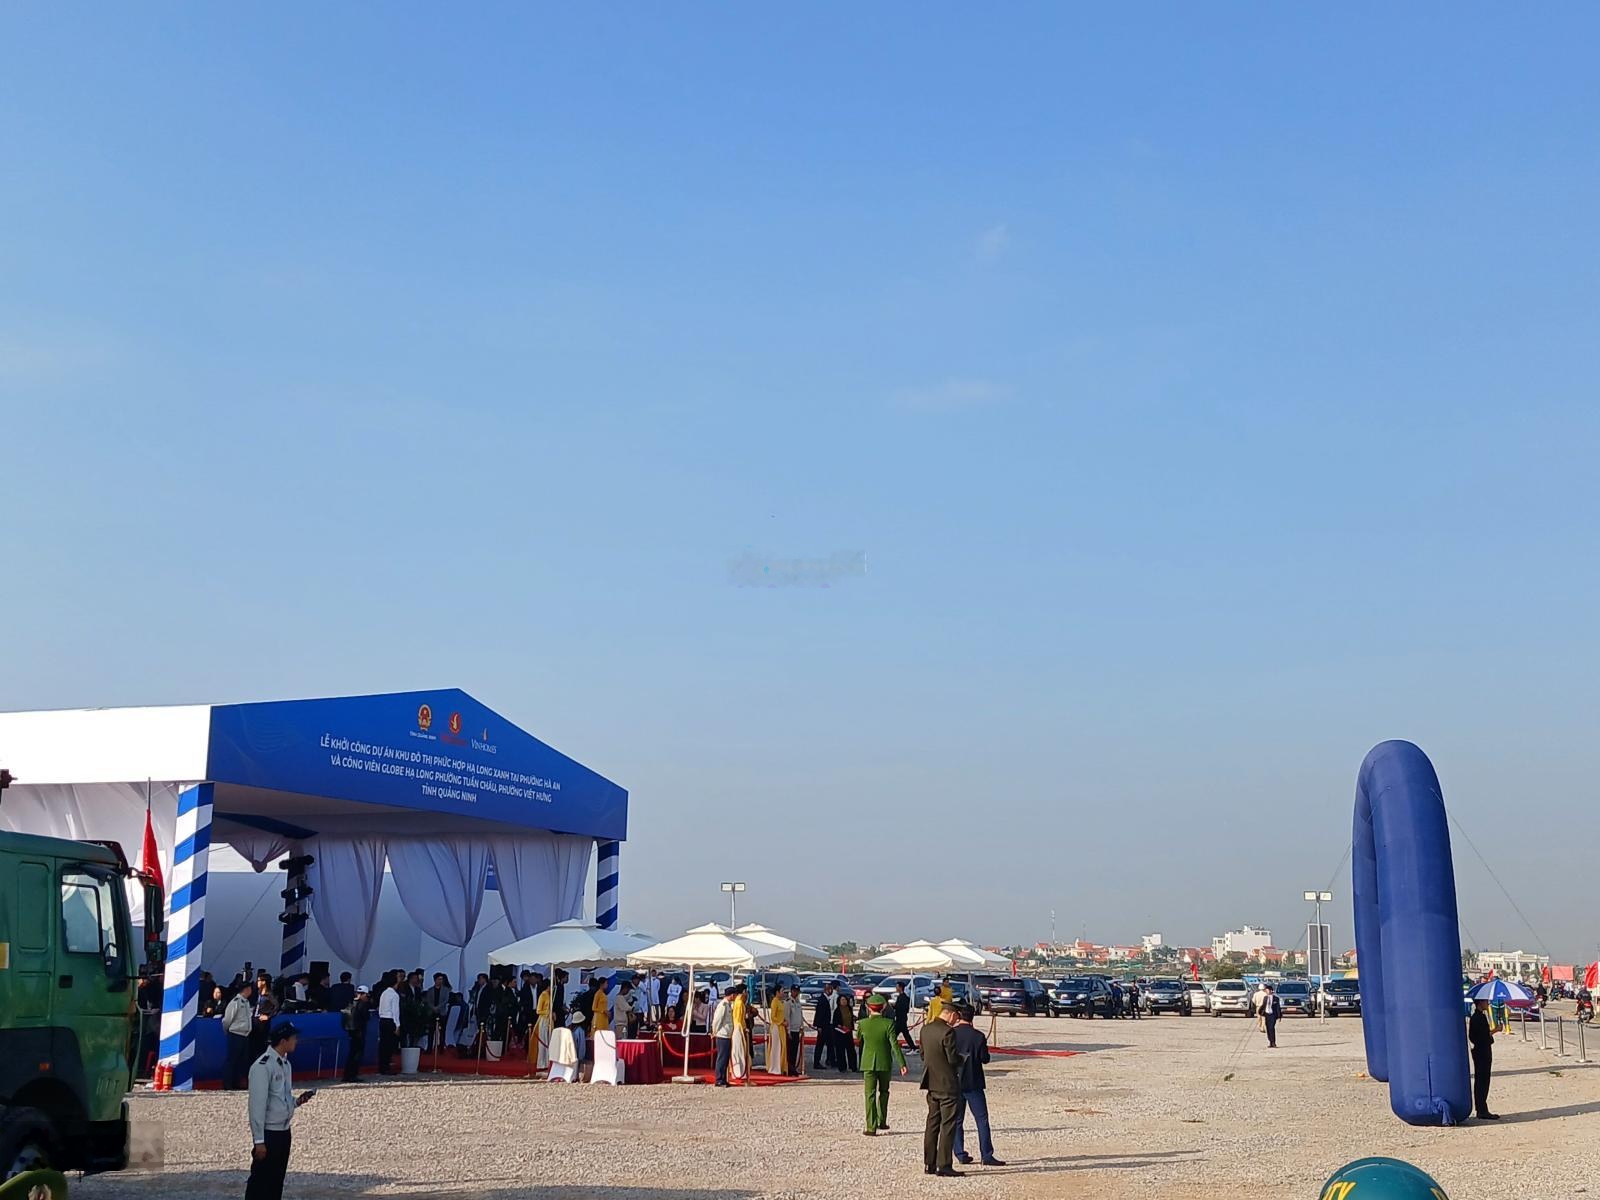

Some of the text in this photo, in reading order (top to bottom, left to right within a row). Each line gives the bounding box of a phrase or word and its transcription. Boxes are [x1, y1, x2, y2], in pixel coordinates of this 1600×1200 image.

[331, 753, 341, 766] VÀ
[342, 756, 363, 770] CÔNG
[364, 760, 381, 772] VIÊN
[381, 764, 404, 776] GLOBE
[405, 767, 415, 780] HẠ
[416, 769, 434, 780] LONG
[350, 741, 371, 754] CÔNG
[372, 746, 384, 758] DỰ
[384, 746, 394, 758] ÁN
[395, 750, 410, 761] KHU
[422, 754, 433, 767] THỊ
[452, 759, 466, 772] HỢP
[466, 763, 476, 774] HẠ
[476, 764, 493, 776] LONG
[493, 768, 510, 780] XANH
[438, 786, 461, 799] QUẢNG
[461, 791, 477, 803] NINH
